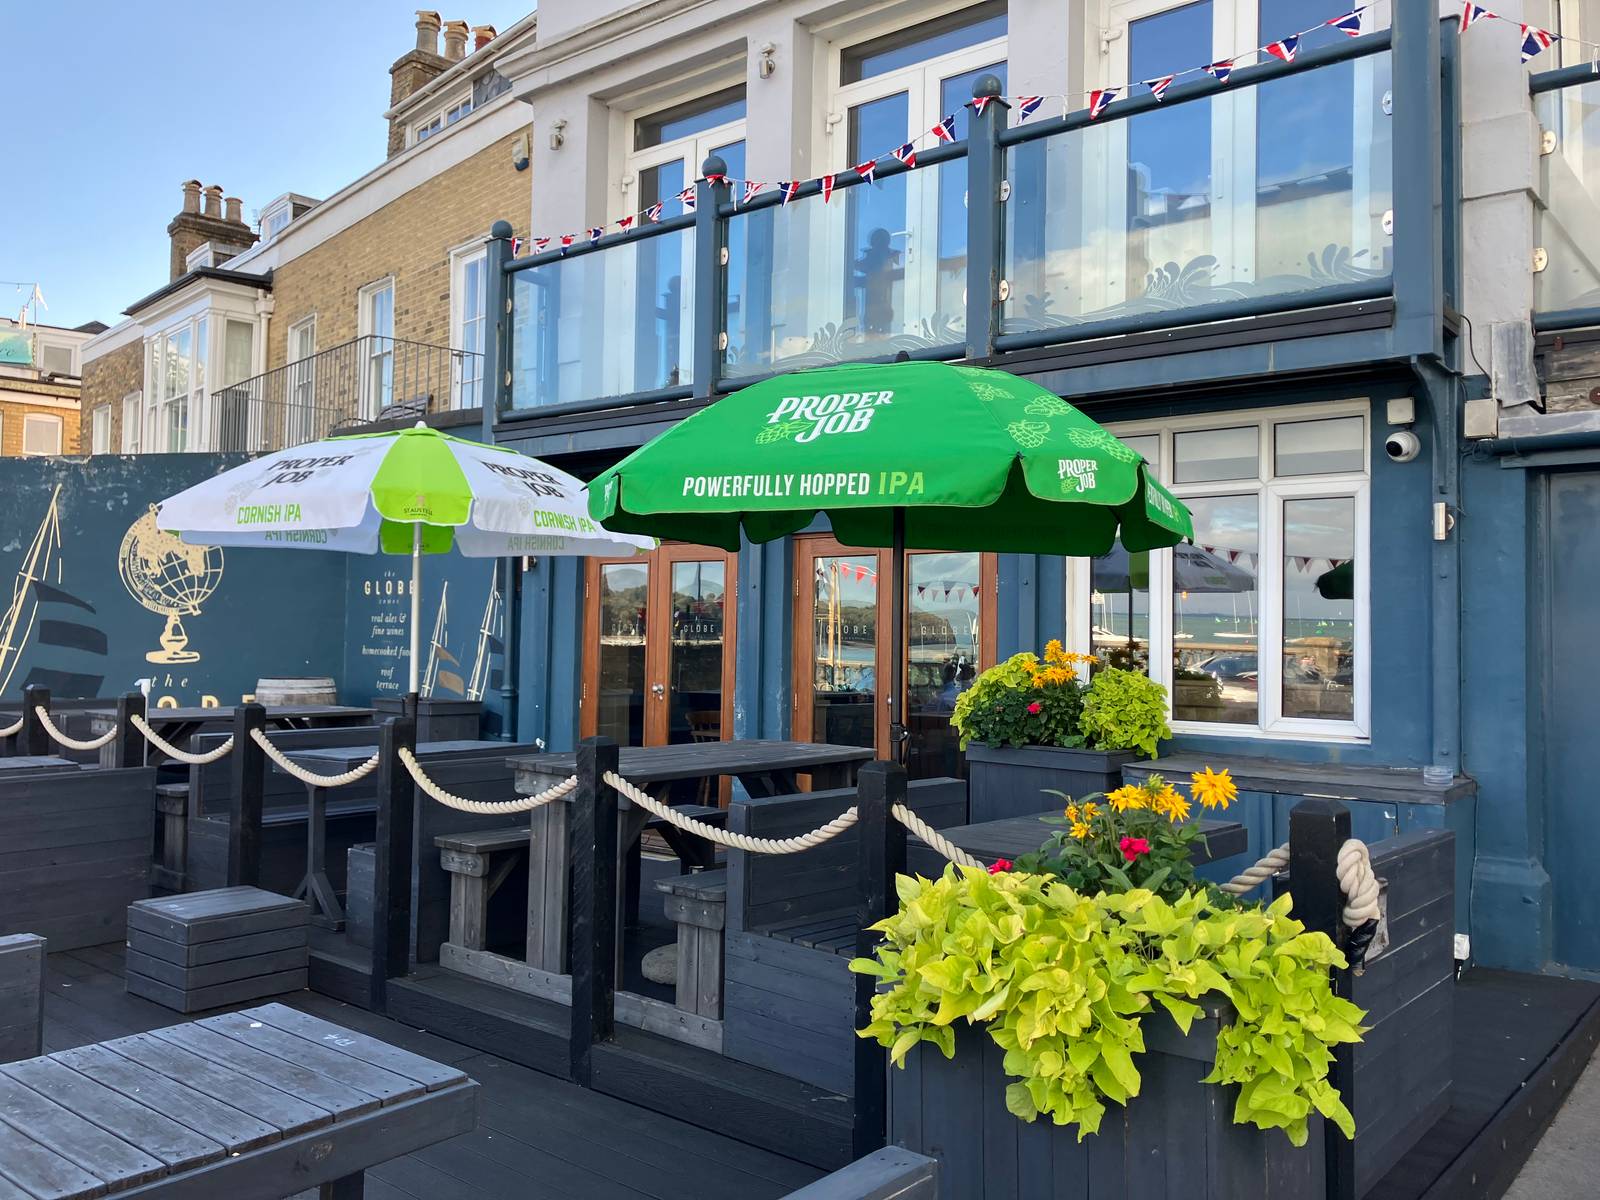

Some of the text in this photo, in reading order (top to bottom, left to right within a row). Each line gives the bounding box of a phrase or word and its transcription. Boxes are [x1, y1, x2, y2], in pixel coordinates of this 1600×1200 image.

[766, 391, 894, 424] PROPER
[794, 408, 875, 443] JOB
[267, 455, 354, 471] PROPER
[480, 460, 564, 487] PROPER
[1057, 458, 1098, 479] PROPER
[260, 470, 314, 489] JOB
[522, 480, 565, 498] JOB
[682, 471, 925, 497] POWERFULLY HOPPED IPA
[1076, 472, 1096, 493] JOB
[237, 503, 302, 525] CORNISH IPA
[533, 510, 597, 533] CORNISH IPA
[683, 624, 715, 633] GLOBE
[151, 673, 188, 688] the
